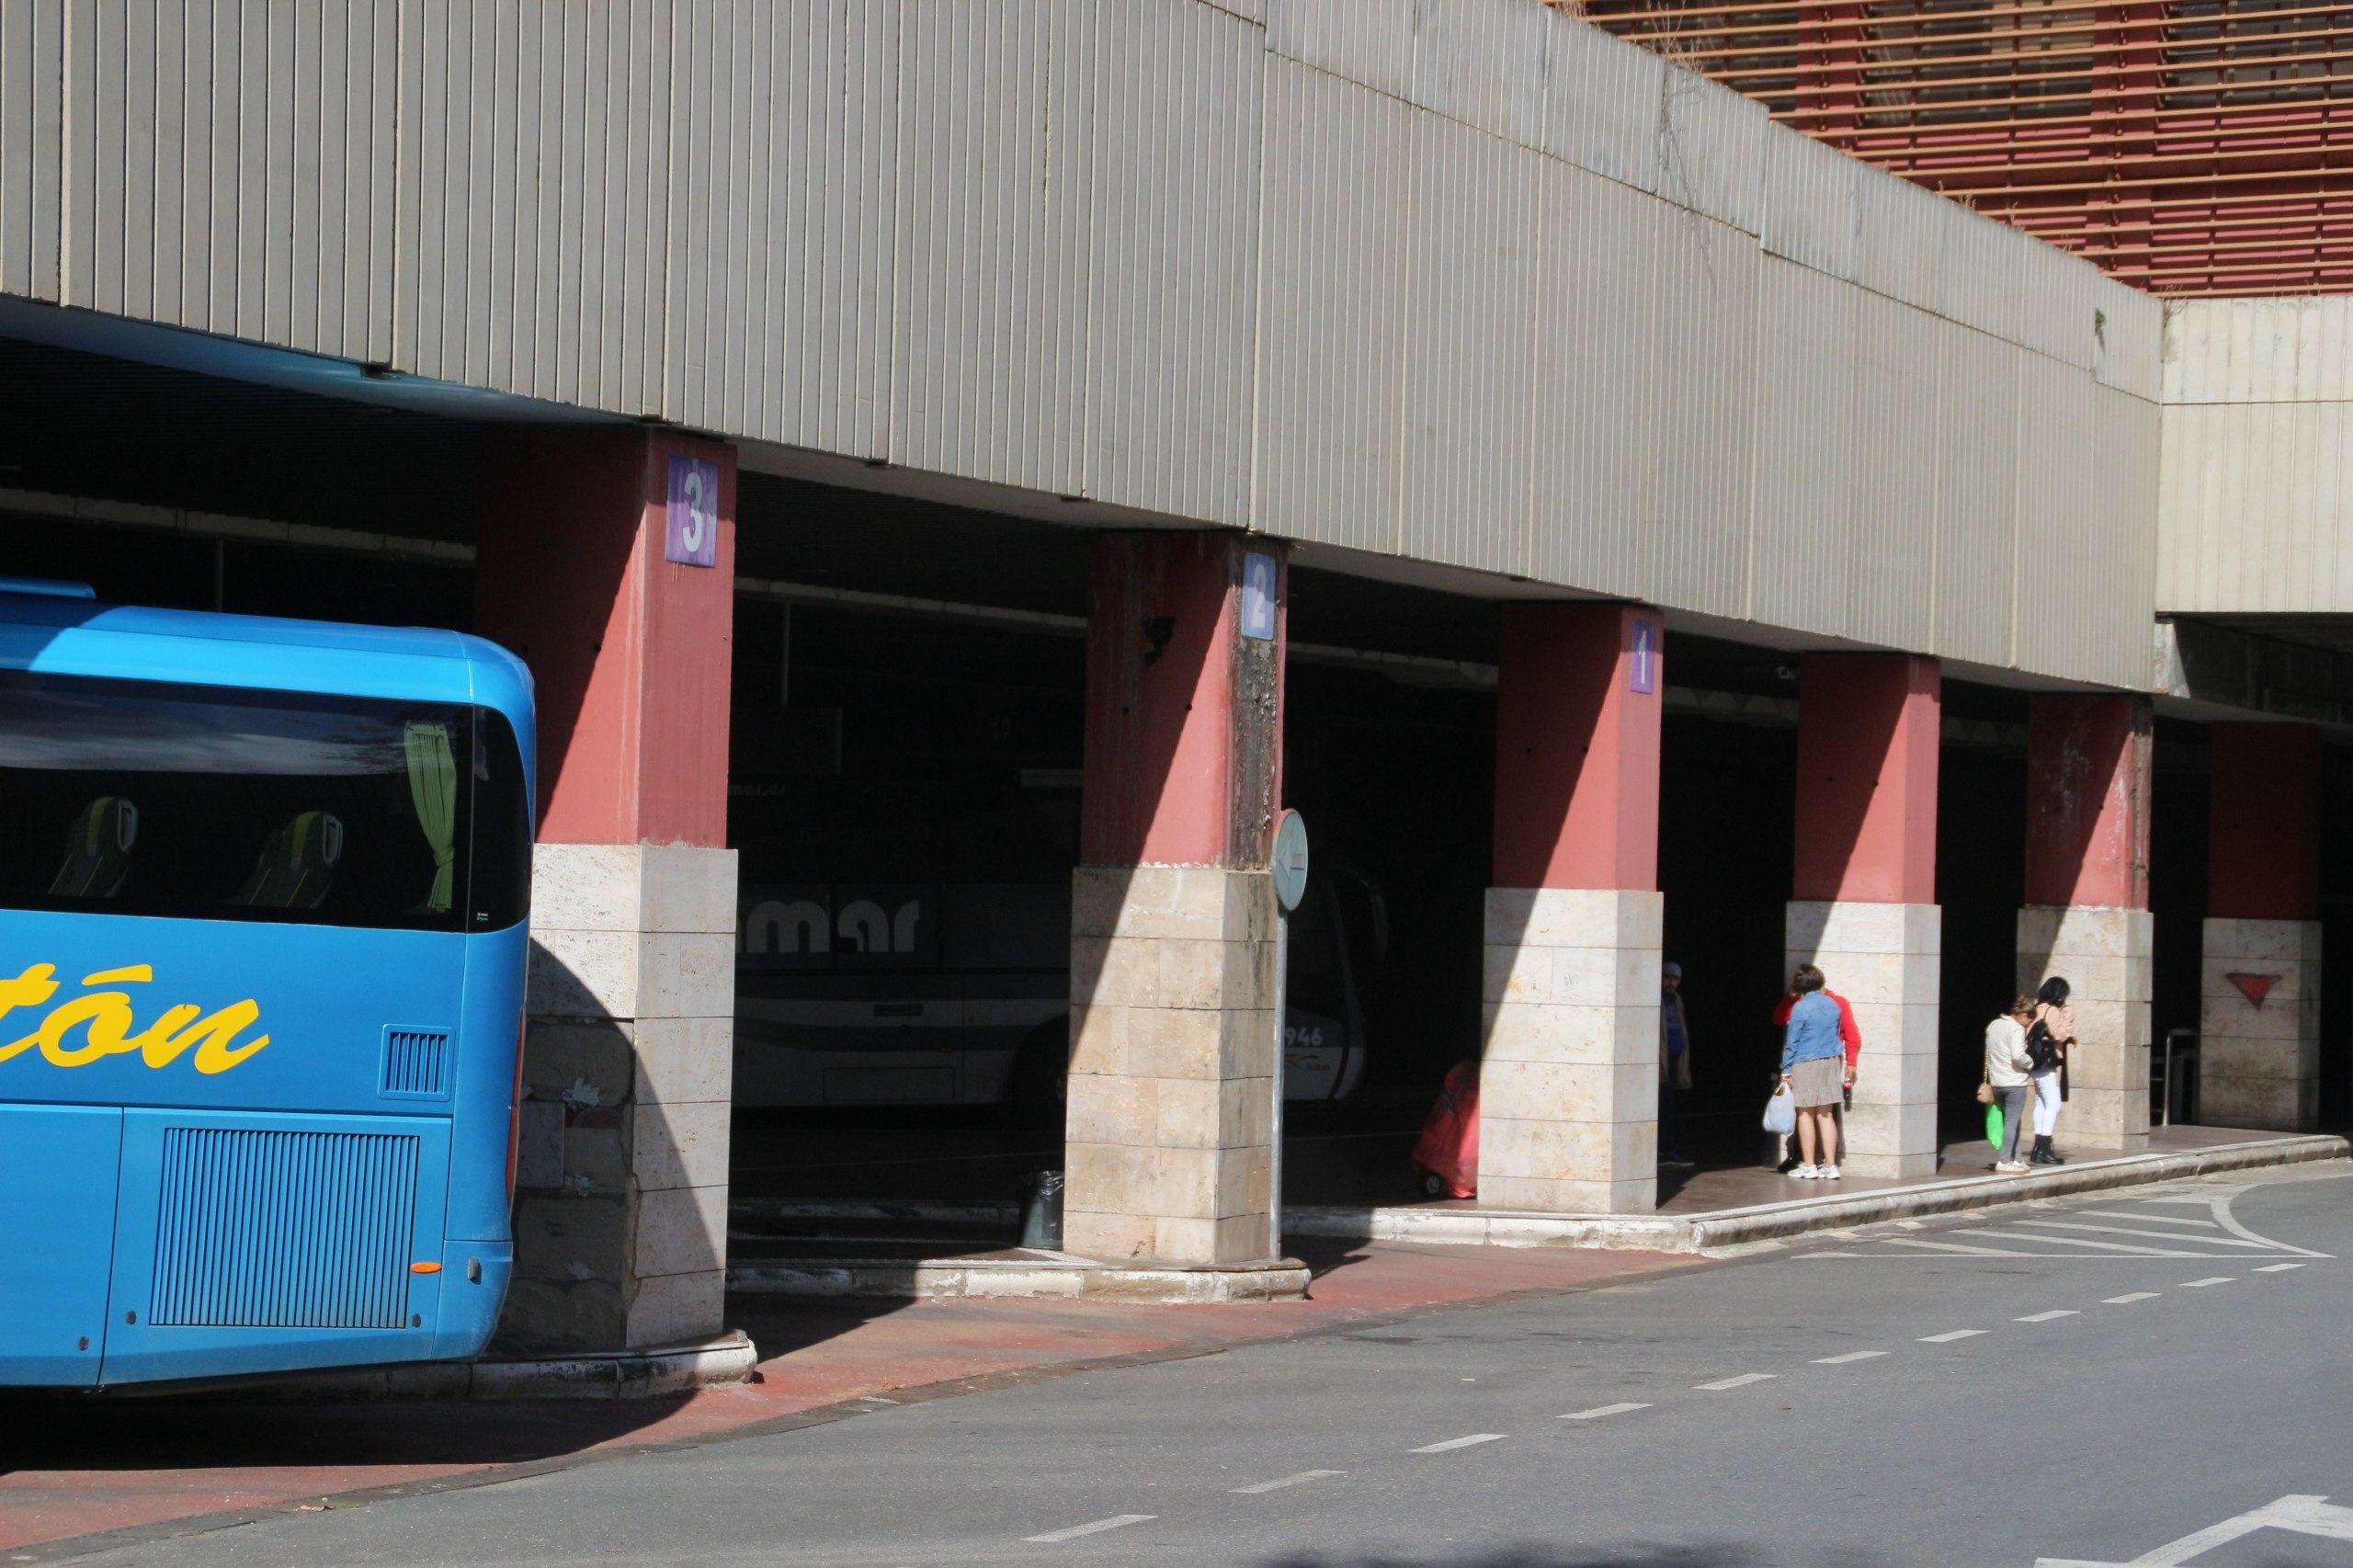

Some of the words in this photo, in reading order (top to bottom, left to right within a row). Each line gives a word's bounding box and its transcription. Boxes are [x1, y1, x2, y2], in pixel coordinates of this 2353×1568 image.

[682, 472, 703, 552] 3
[1251, 562, 1267, 629] 2
[1638, 630, 1647, 684] 1
